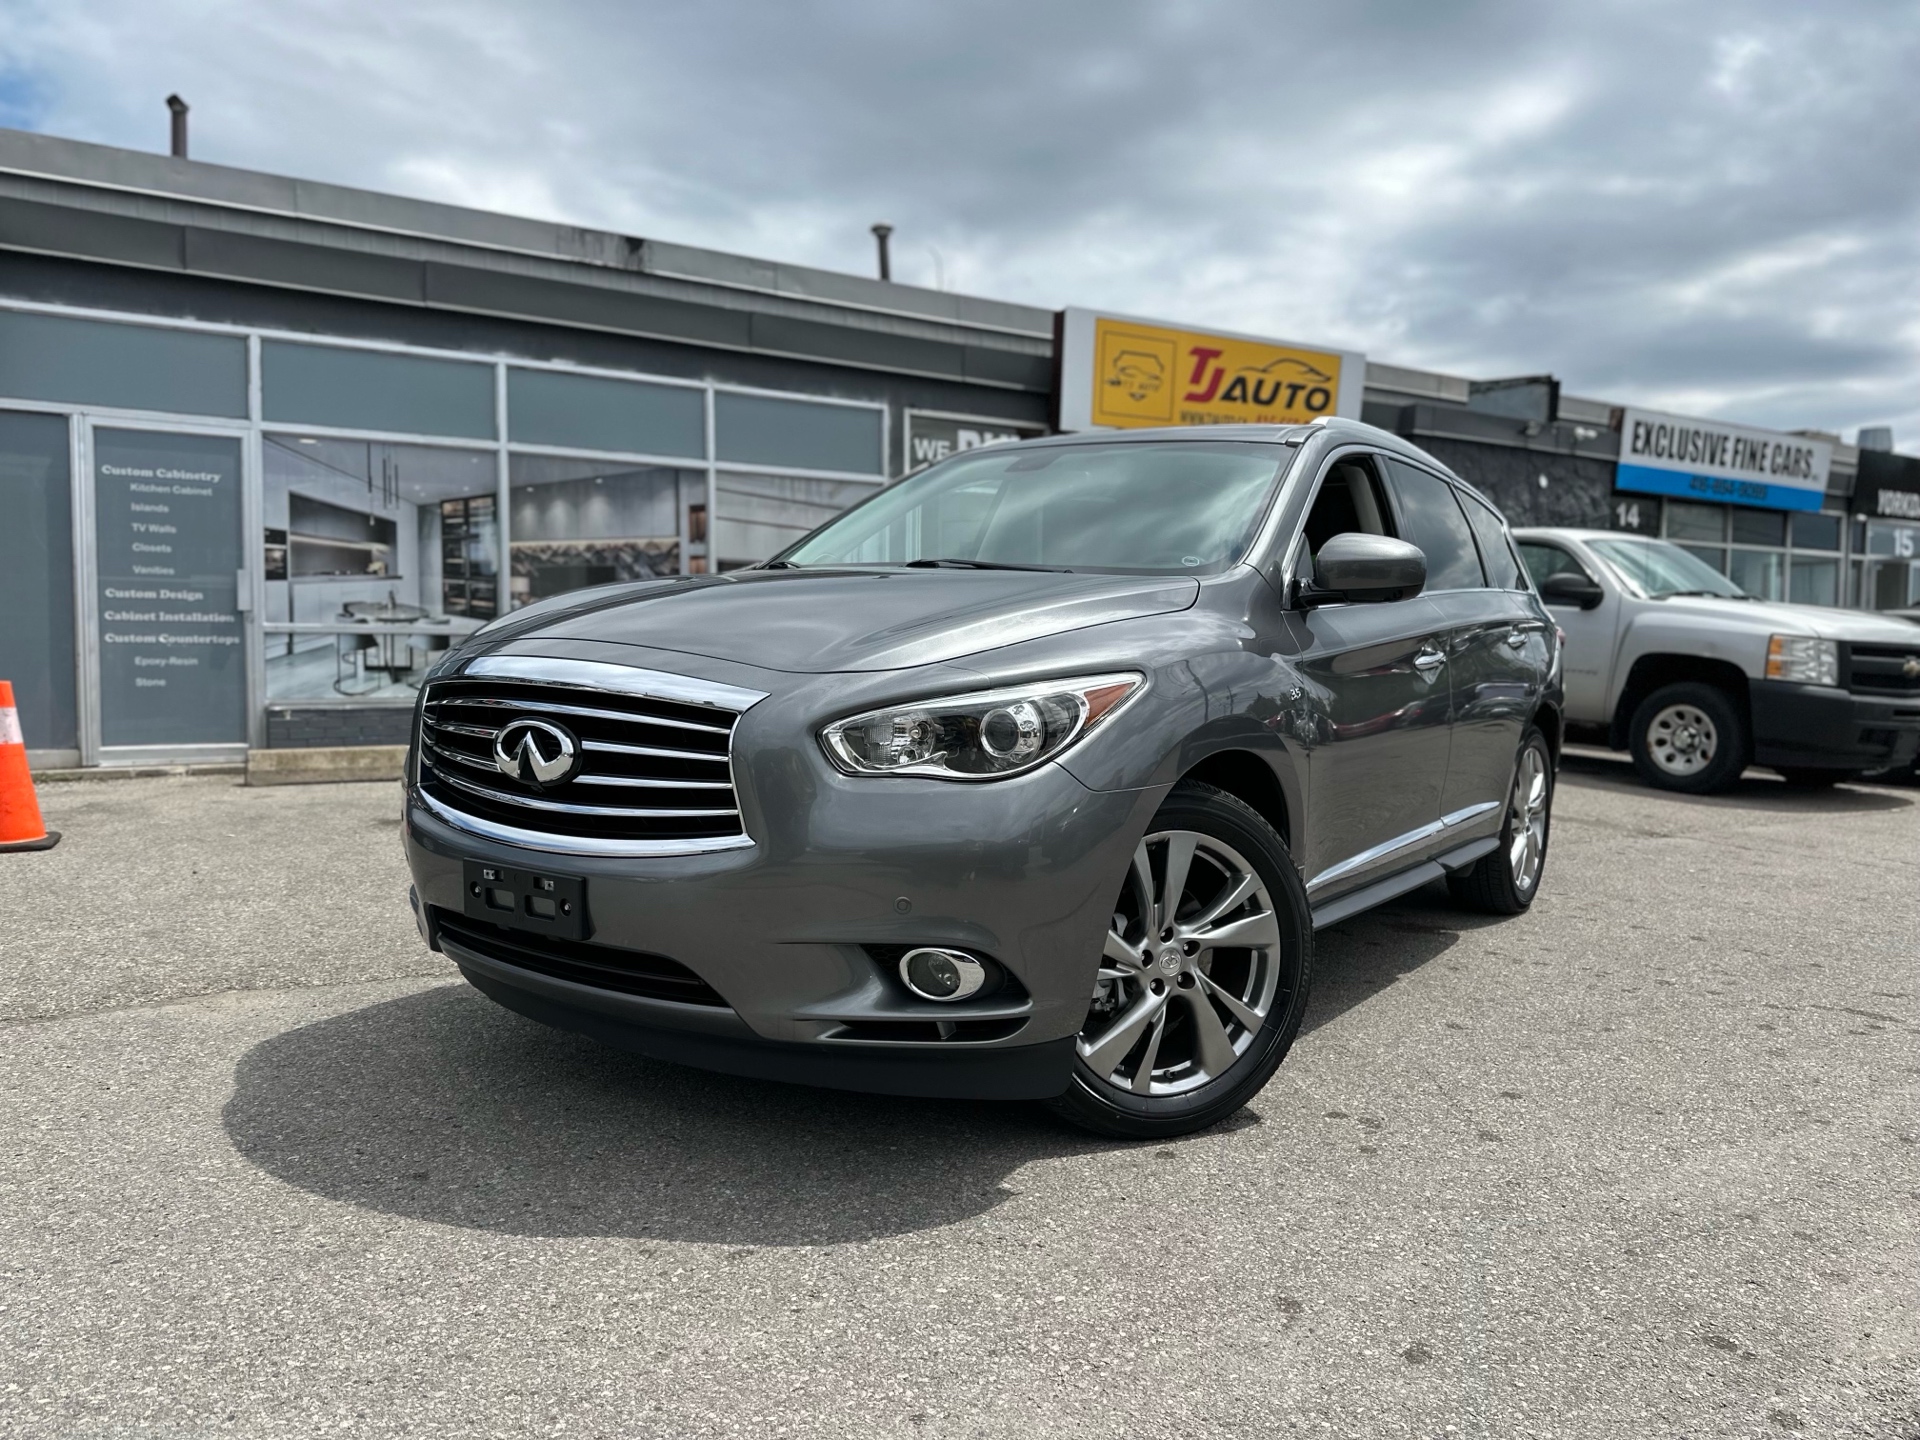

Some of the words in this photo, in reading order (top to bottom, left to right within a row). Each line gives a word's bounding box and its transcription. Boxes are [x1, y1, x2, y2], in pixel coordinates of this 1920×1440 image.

[1184, 346, 1225, 402] TJ
[1220, 375, 1331, 412] AUTO
[913, 437, 950, 460] WE
[1630, 420, 1730, 467] EXCLUSIVE
[1731, 436, 1769, 474] FINE
[101, 464, 154, 478] Custom
[156, 468, 221, 483] Cabinetry
[130, 482, 170, 494] Kitchen
[172, 485, 213, 496] Cabinet
[131, 502, 169, 513] Islands
[1616, 502, 1640, 528] 14
[131, 523, 147, 532] TV
[148, 524, 177, 534] Walls
[132, 542, 172, 553] Closets
[1893, 529, 1914, 557] 15
[132, 565, 175, 575] Vanities
[104, 588, 157, 599] Custom
[159, 589, 204, 602] Design
[104, 610, 156, 622] Cabinet
[158, 611, 235, 623] Installation
[104, 633, 157, 644] Custom
[158, 633, 240, 646] Countertops
[135, 678, 166, 687] Stone
